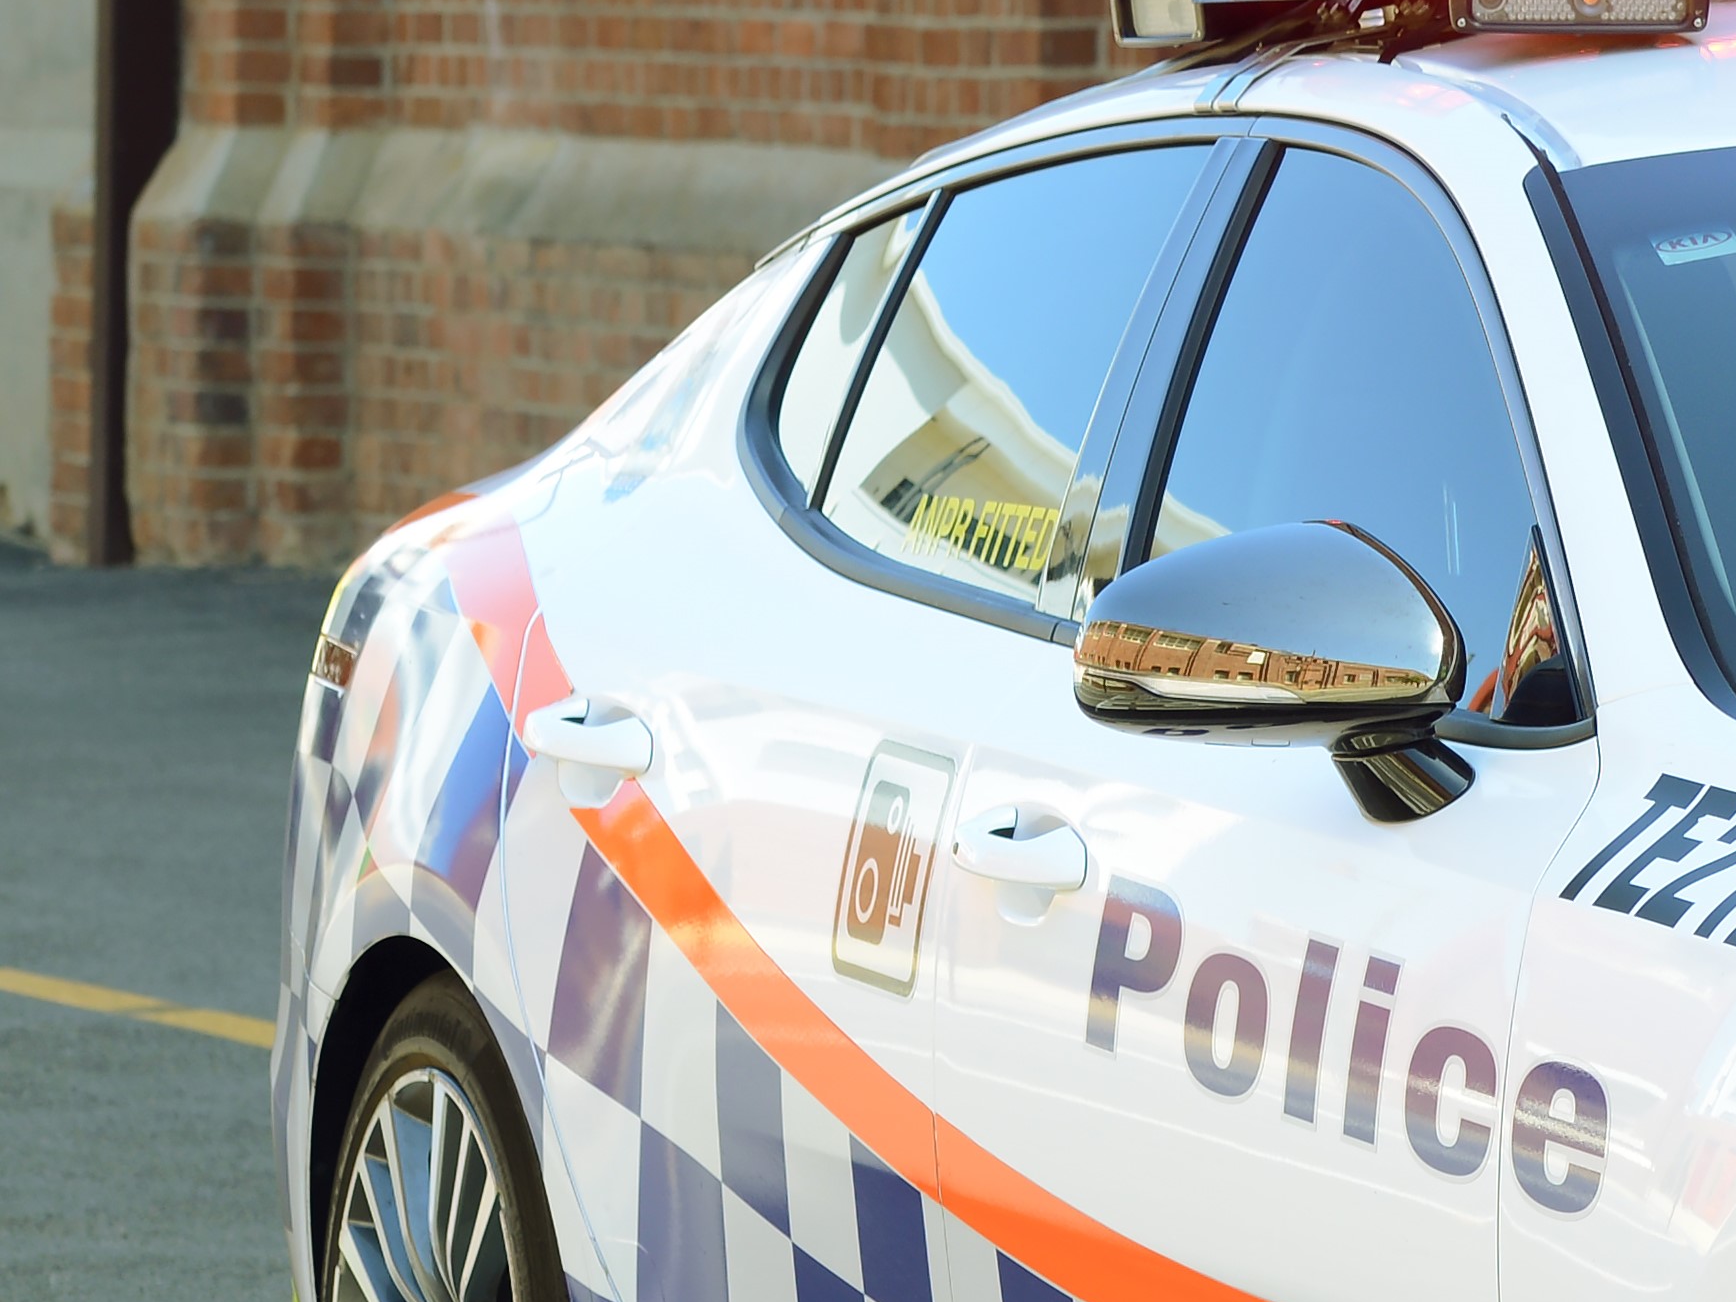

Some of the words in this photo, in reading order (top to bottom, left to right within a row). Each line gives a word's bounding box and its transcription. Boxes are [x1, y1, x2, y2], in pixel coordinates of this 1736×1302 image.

[1668, 233, 1721, 250] KIA
[901, 493, 975, 559] ANPR
[967, 500, 1060, 571] FITTED
[1084, 873, 1610, 1215] Police
